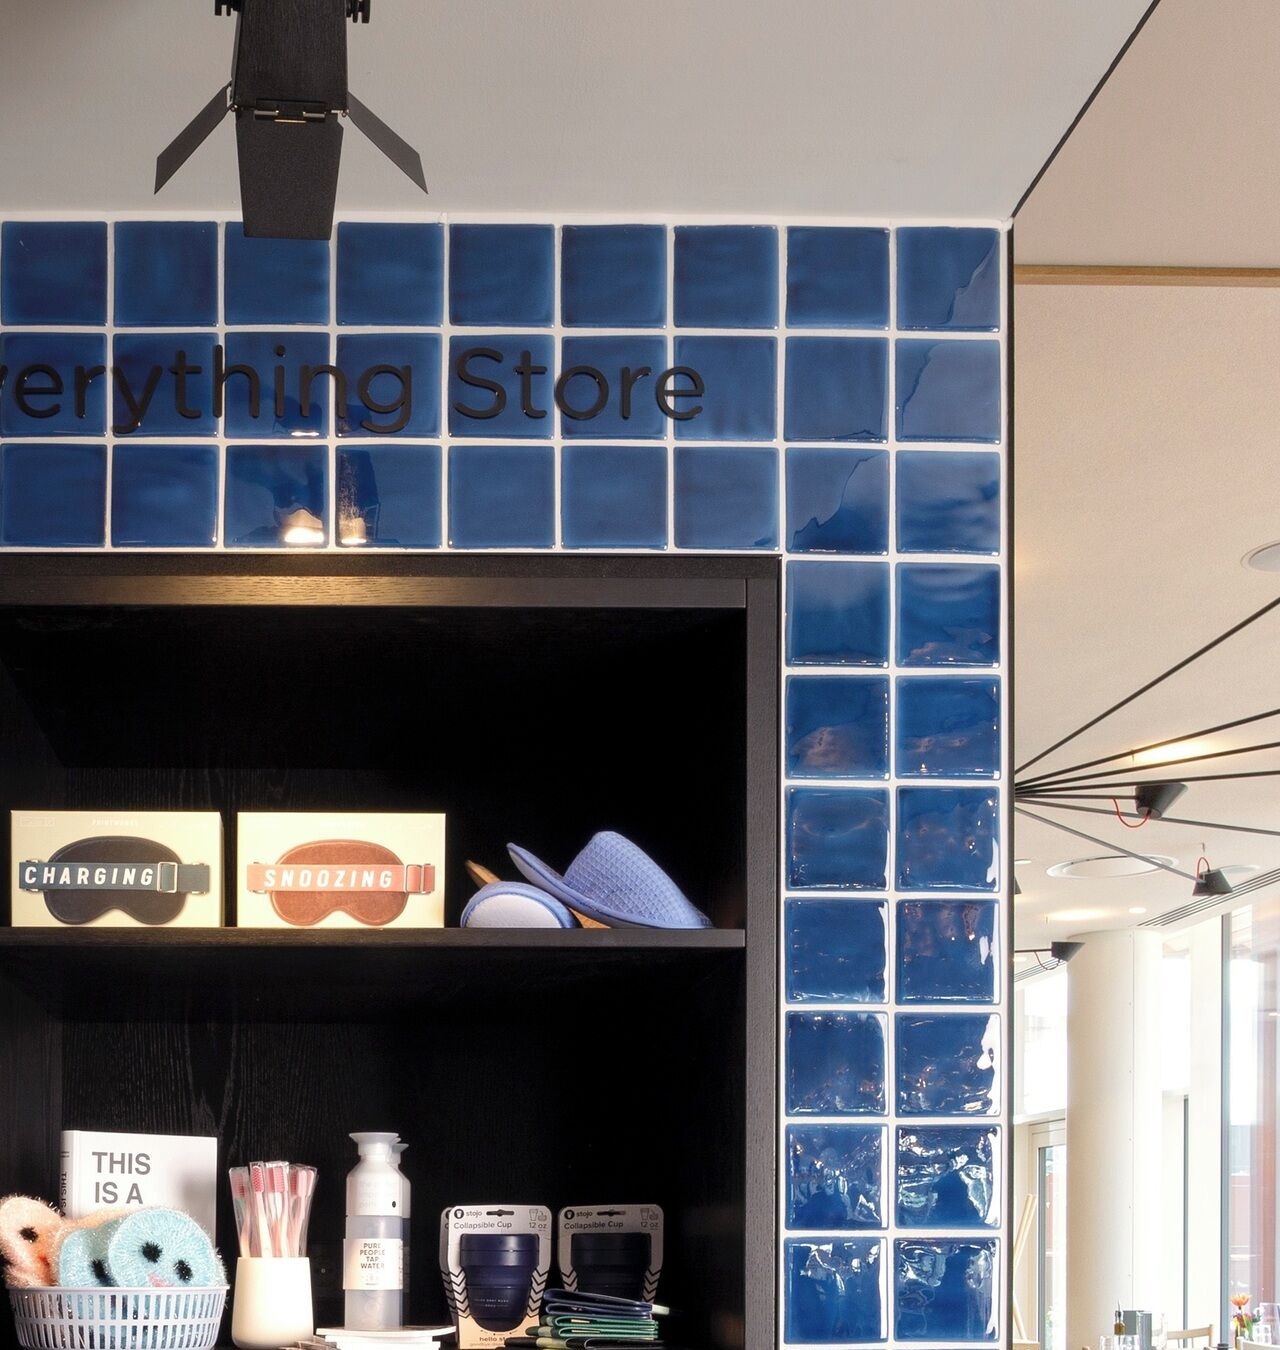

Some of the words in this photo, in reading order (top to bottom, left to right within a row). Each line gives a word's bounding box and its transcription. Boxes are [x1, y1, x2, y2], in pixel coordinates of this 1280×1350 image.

[449, 346, 706, 423] Store
[24, 866, 155, 887] CHARGING
[263, 868, 394, 889] SNOOZING
[91, 1151, 152, 1175] THIS
[95, 1181, 118, 1205] IS
[125, 1183, 144, 1205] A
[465, 1210, 483, 1218] stojo
[575, 1210, 593, 1218] stojo
[453, 1222, 495, 1231] Collapsible
[496, 1221, 513, 1230] Cup
[563, 1222, 606, 1231] Collapsible
[607, 1220, 624, 1230] Cup
